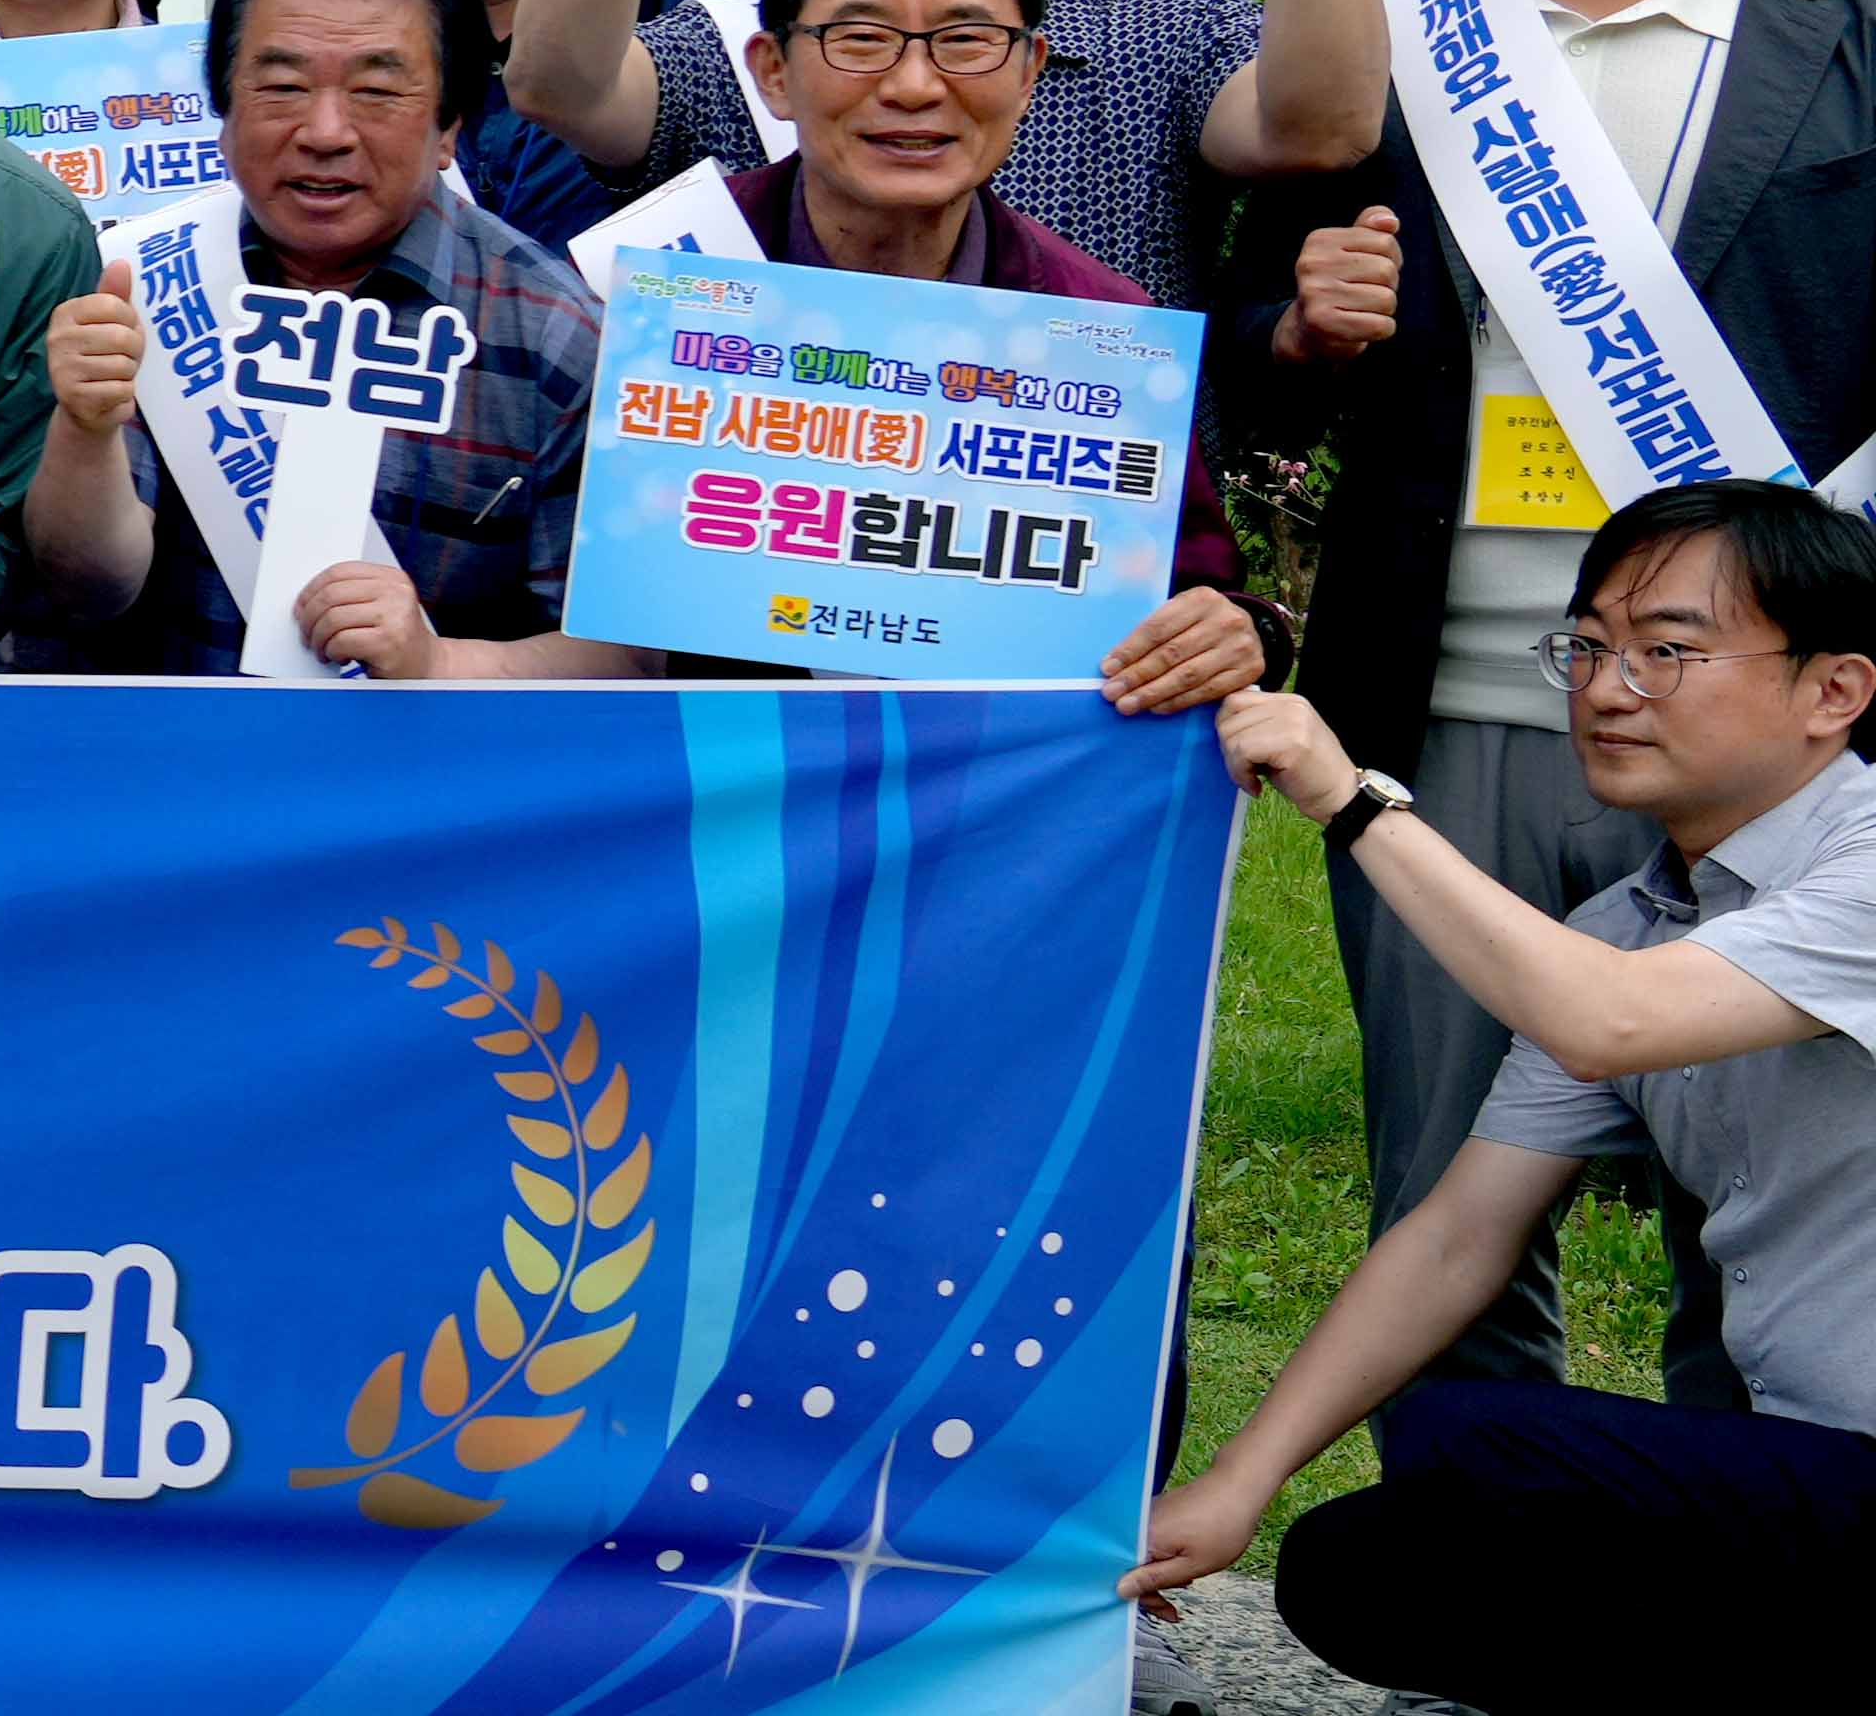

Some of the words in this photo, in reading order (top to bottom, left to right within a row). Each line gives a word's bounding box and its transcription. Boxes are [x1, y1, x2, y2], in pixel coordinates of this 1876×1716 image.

[103, 92, 203, 129] 행복한
[139, 222, 223, 398] 함께해요
[233, 293, 466, 425] 전남
[672, 331, 783, 376] 마음을
[791, 344, 928, 395] 함께하는
[939, 362, 1048, 411] 행복한
[1056, 380, 1121, 417] 이음
[619, 384, 710, 440] 전남
[721, 393, 923, 467] 사랑애(愛)
[939, 420, 1163, 498] 서포터즈를
[684, 475, 1094, 592] 응원합니다
[811, 604, 941, 645] 전라남도
